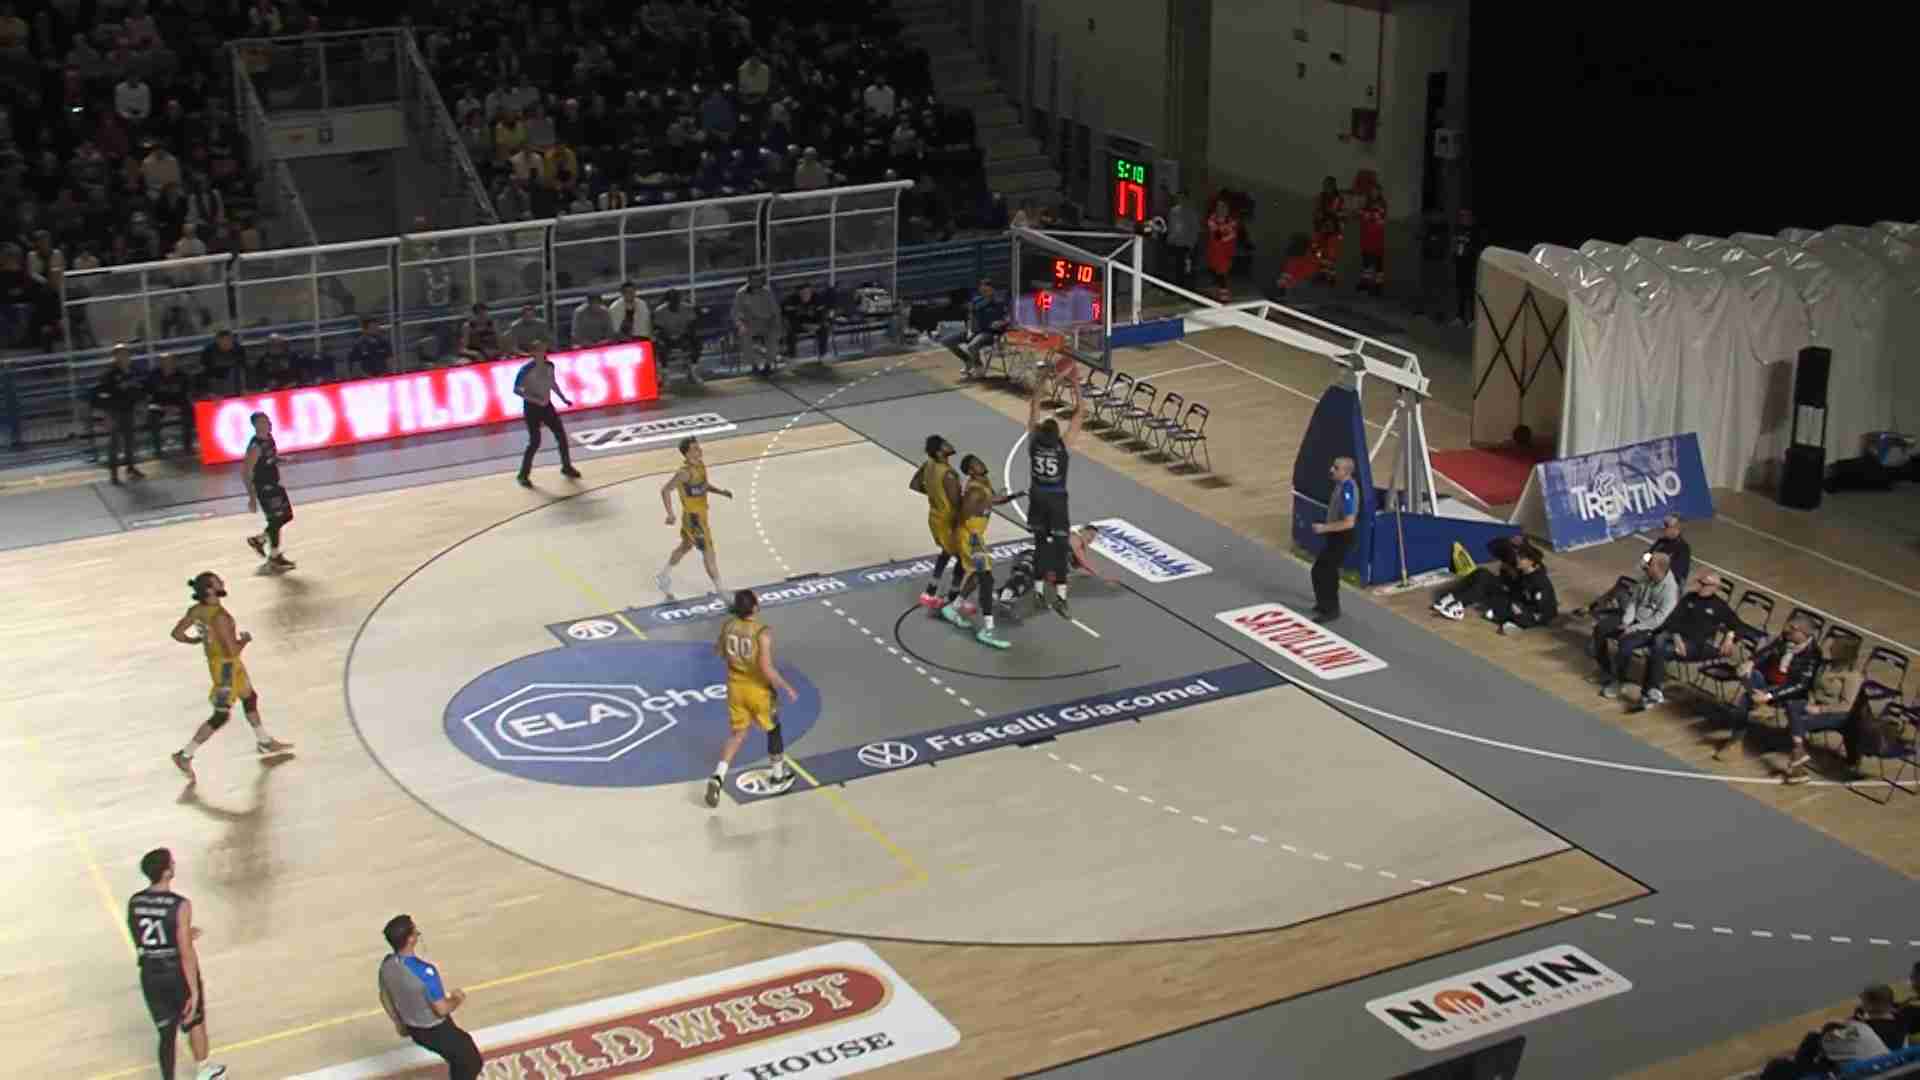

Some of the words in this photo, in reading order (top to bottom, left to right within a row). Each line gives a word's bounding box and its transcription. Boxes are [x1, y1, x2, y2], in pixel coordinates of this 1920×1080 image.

[1117, 160, 1144, 184] 5:10
[1118, 181, 1145, 221] 17
[1055, 261, 1093, 282] 5:10
[213, 389, 335, 456] OLD
[338, 369, 489, 438] WILD
[1034, 457, 1059, 477] 35
[1570, 470, 1682, 521] TRENTINO
[1233, 611, 1369, 671] SATOLLINI
[511, 702, 630, 738] ELA
[925, 711, 1056, 753] Fratelli
[1058, 679, 1220, 723] Giacomel
[139, 917, 168, 946] 21
[648, 973, 854, 1049] WEST
[1385, 954, 1601, 1031] NOLFIN
[744, 1031, 895, 1080] HOUSE
